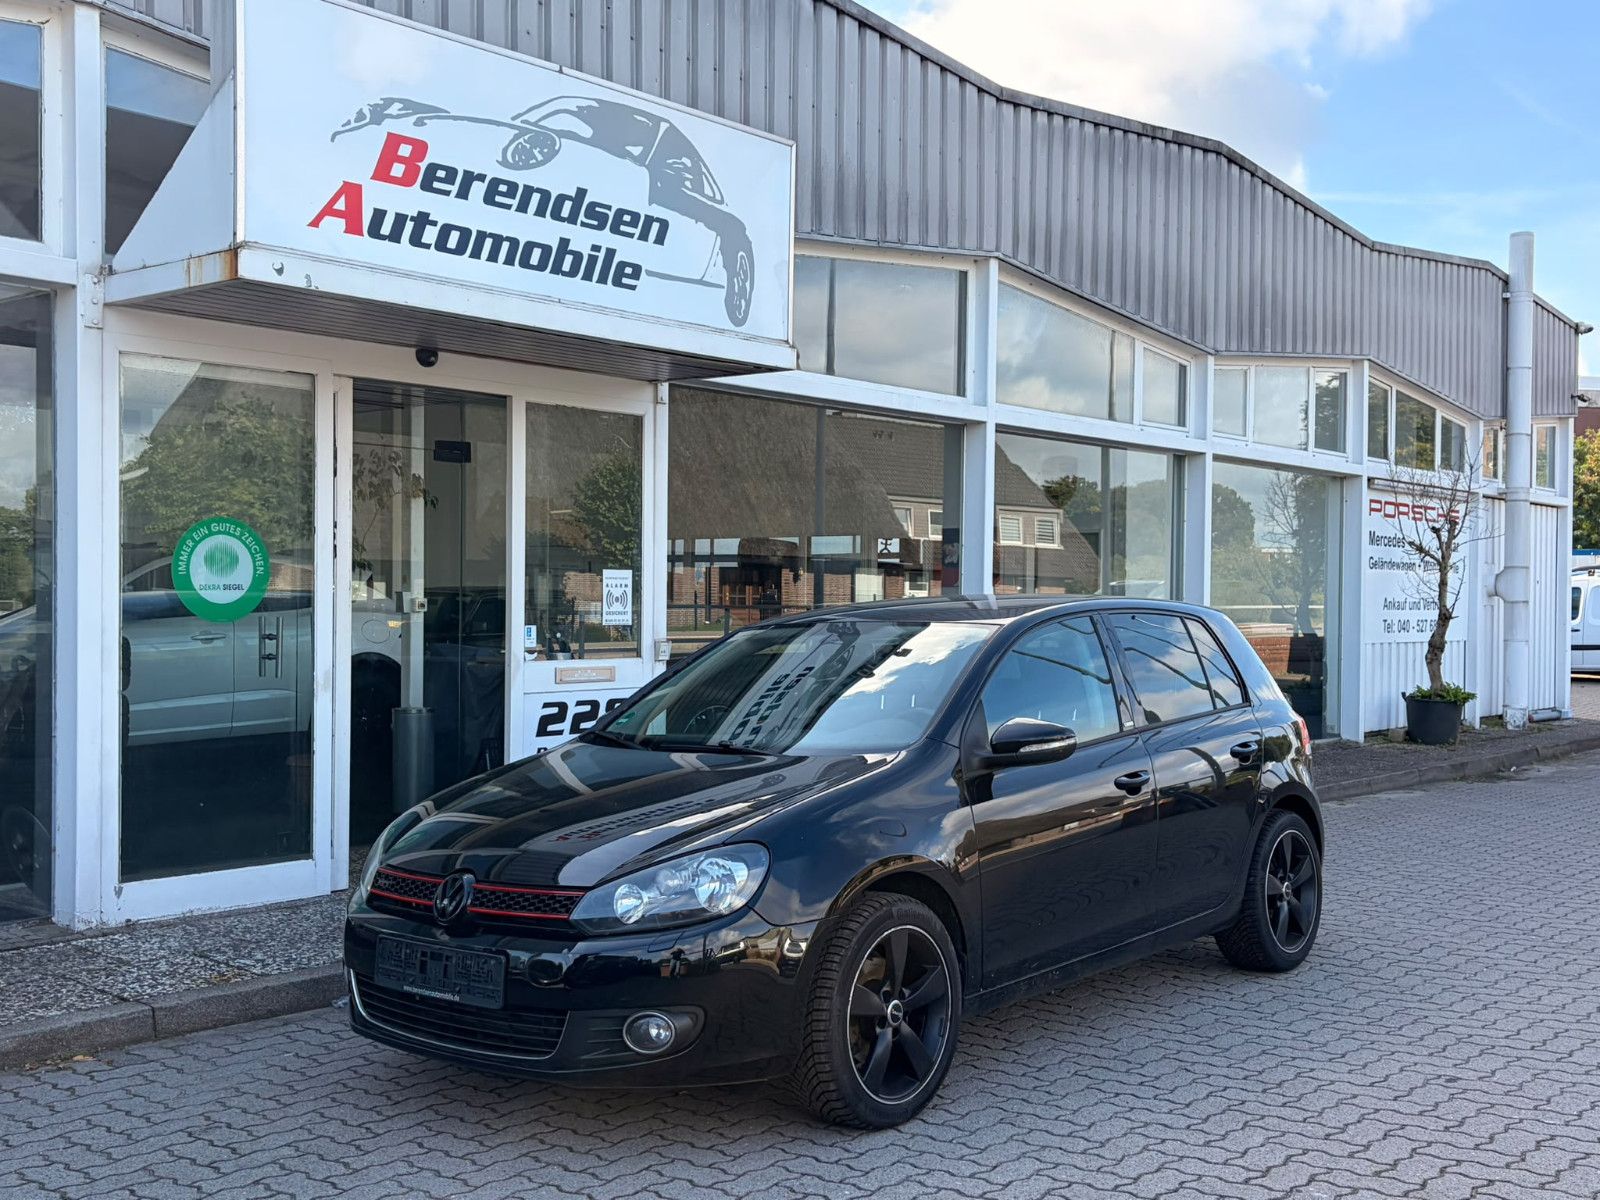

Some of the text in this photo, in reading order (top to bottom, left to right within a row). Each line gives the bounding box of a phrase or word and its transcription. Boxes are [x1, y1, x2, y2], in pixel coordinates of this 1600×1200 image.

[370, 131, 670, 246] Berendsen
[307, 180, 643, 291] Automobile
[1369, 498, 1460, 525] PORSCHE
[178, 539, 195, 575] IMMER
[192, 526, 209, 541] EIN
[210, 522, 241, 536] GUTES
[1368, 530, 1405, 549] Mercedes
[1368, 556, 1417, 572] Geländewagen
[199, 583, 245, 591] DEKRA SIEGEL
[1382, 597, 1407, 611] Ankauf
[1408, 597, 1421, 611] und
[1397, 619, 1410, 633] 040
[1416, 619, 1428, 633] 527
